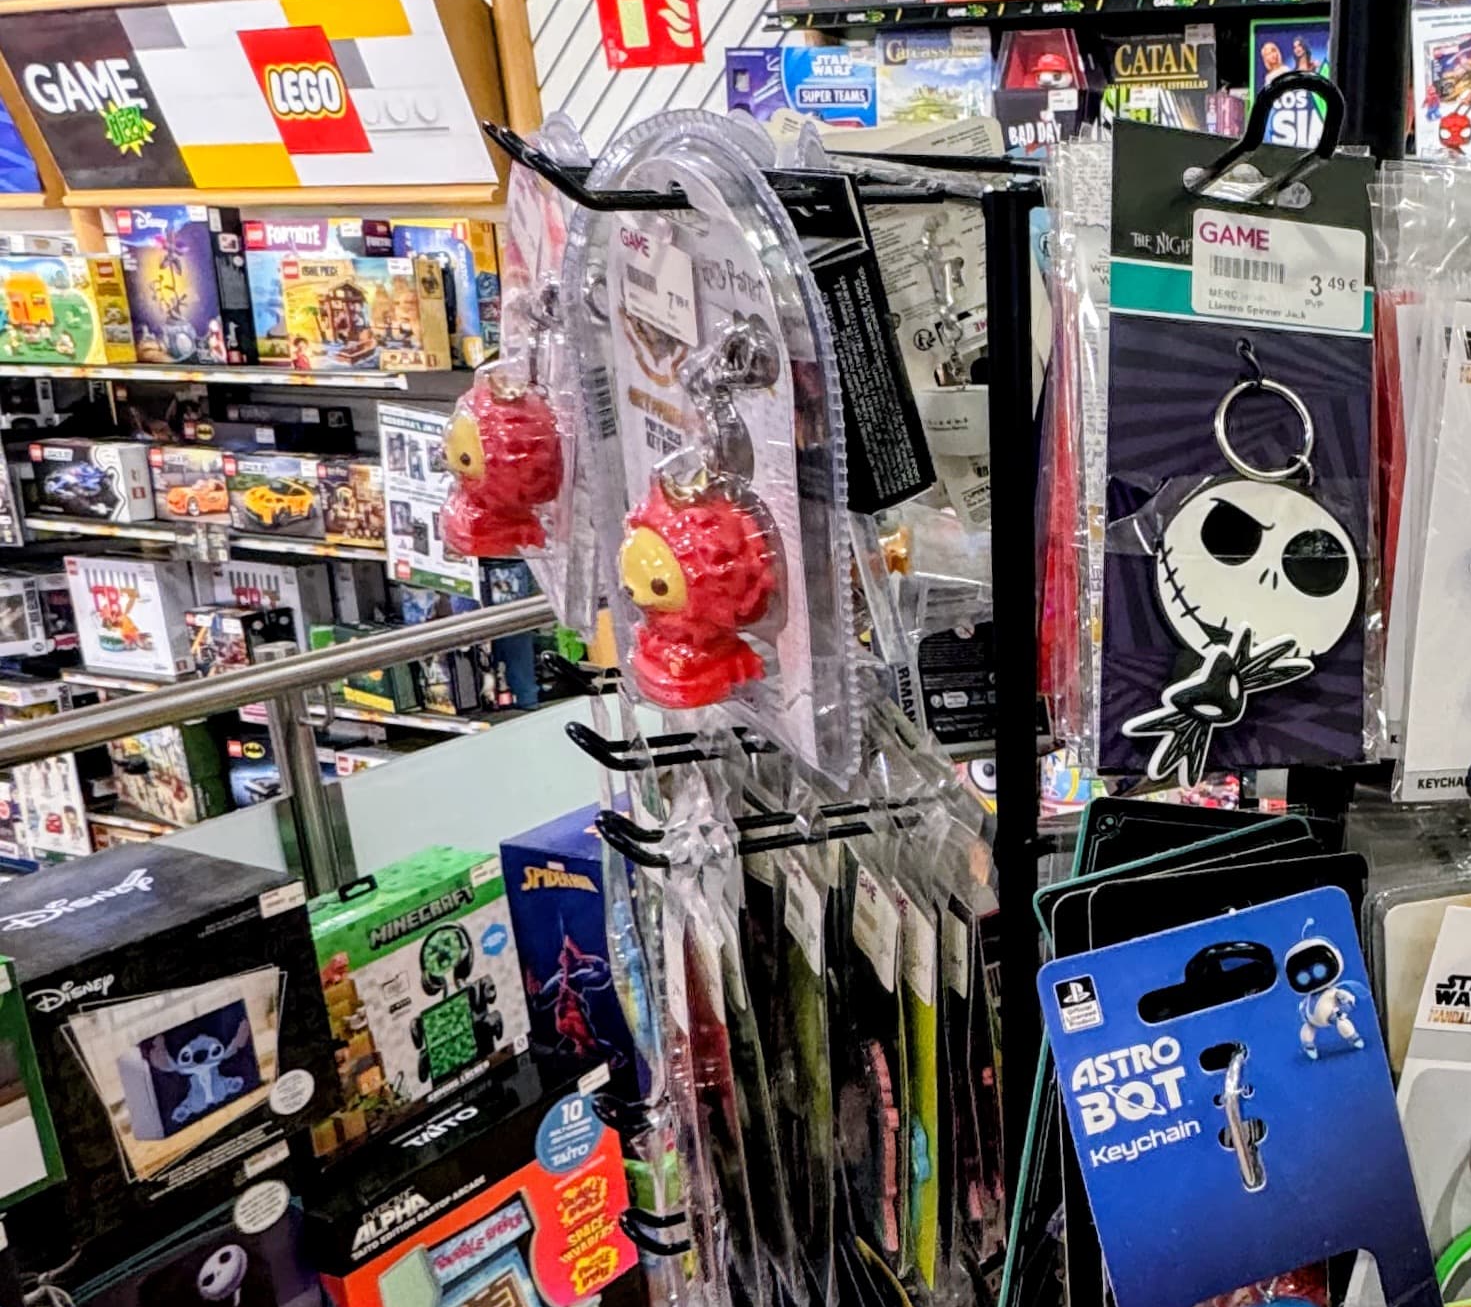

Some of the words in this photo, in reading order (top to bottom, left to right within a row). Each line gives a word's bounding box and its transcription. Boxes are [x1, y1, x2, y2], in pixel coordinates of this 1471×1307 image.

[1114, 43, 1199, 77] CATAN
[25, 58, 148, 114] GAME
[268, 68, 345, 117] LEGO
[801, 88, 833, 104] SUPER
[834, 88, 867, 103] TEAMS
[1008, 127, 1036, 146] BAD
[620, 227, 651, 260] GAME
[1130, 232, 1154, 250] THE
[1199, 221, 1271, 252] GAME
[0, 867, 155, 931] Disney
[369, 885, 475, 952] MINECRAFT
[26, 973, 115, 1013] Disney
[1072, 1036, 1181, 1091] ASTRO
[561, 1099, 584, 1125] 10
[1079, 1065, 1186, 1135] BOT
[401, 1105, 479, 1148] TAITO
[1090, 1118, 1202, 1168] Keychain
[351, 1190, 432, 1252] ALPHA
